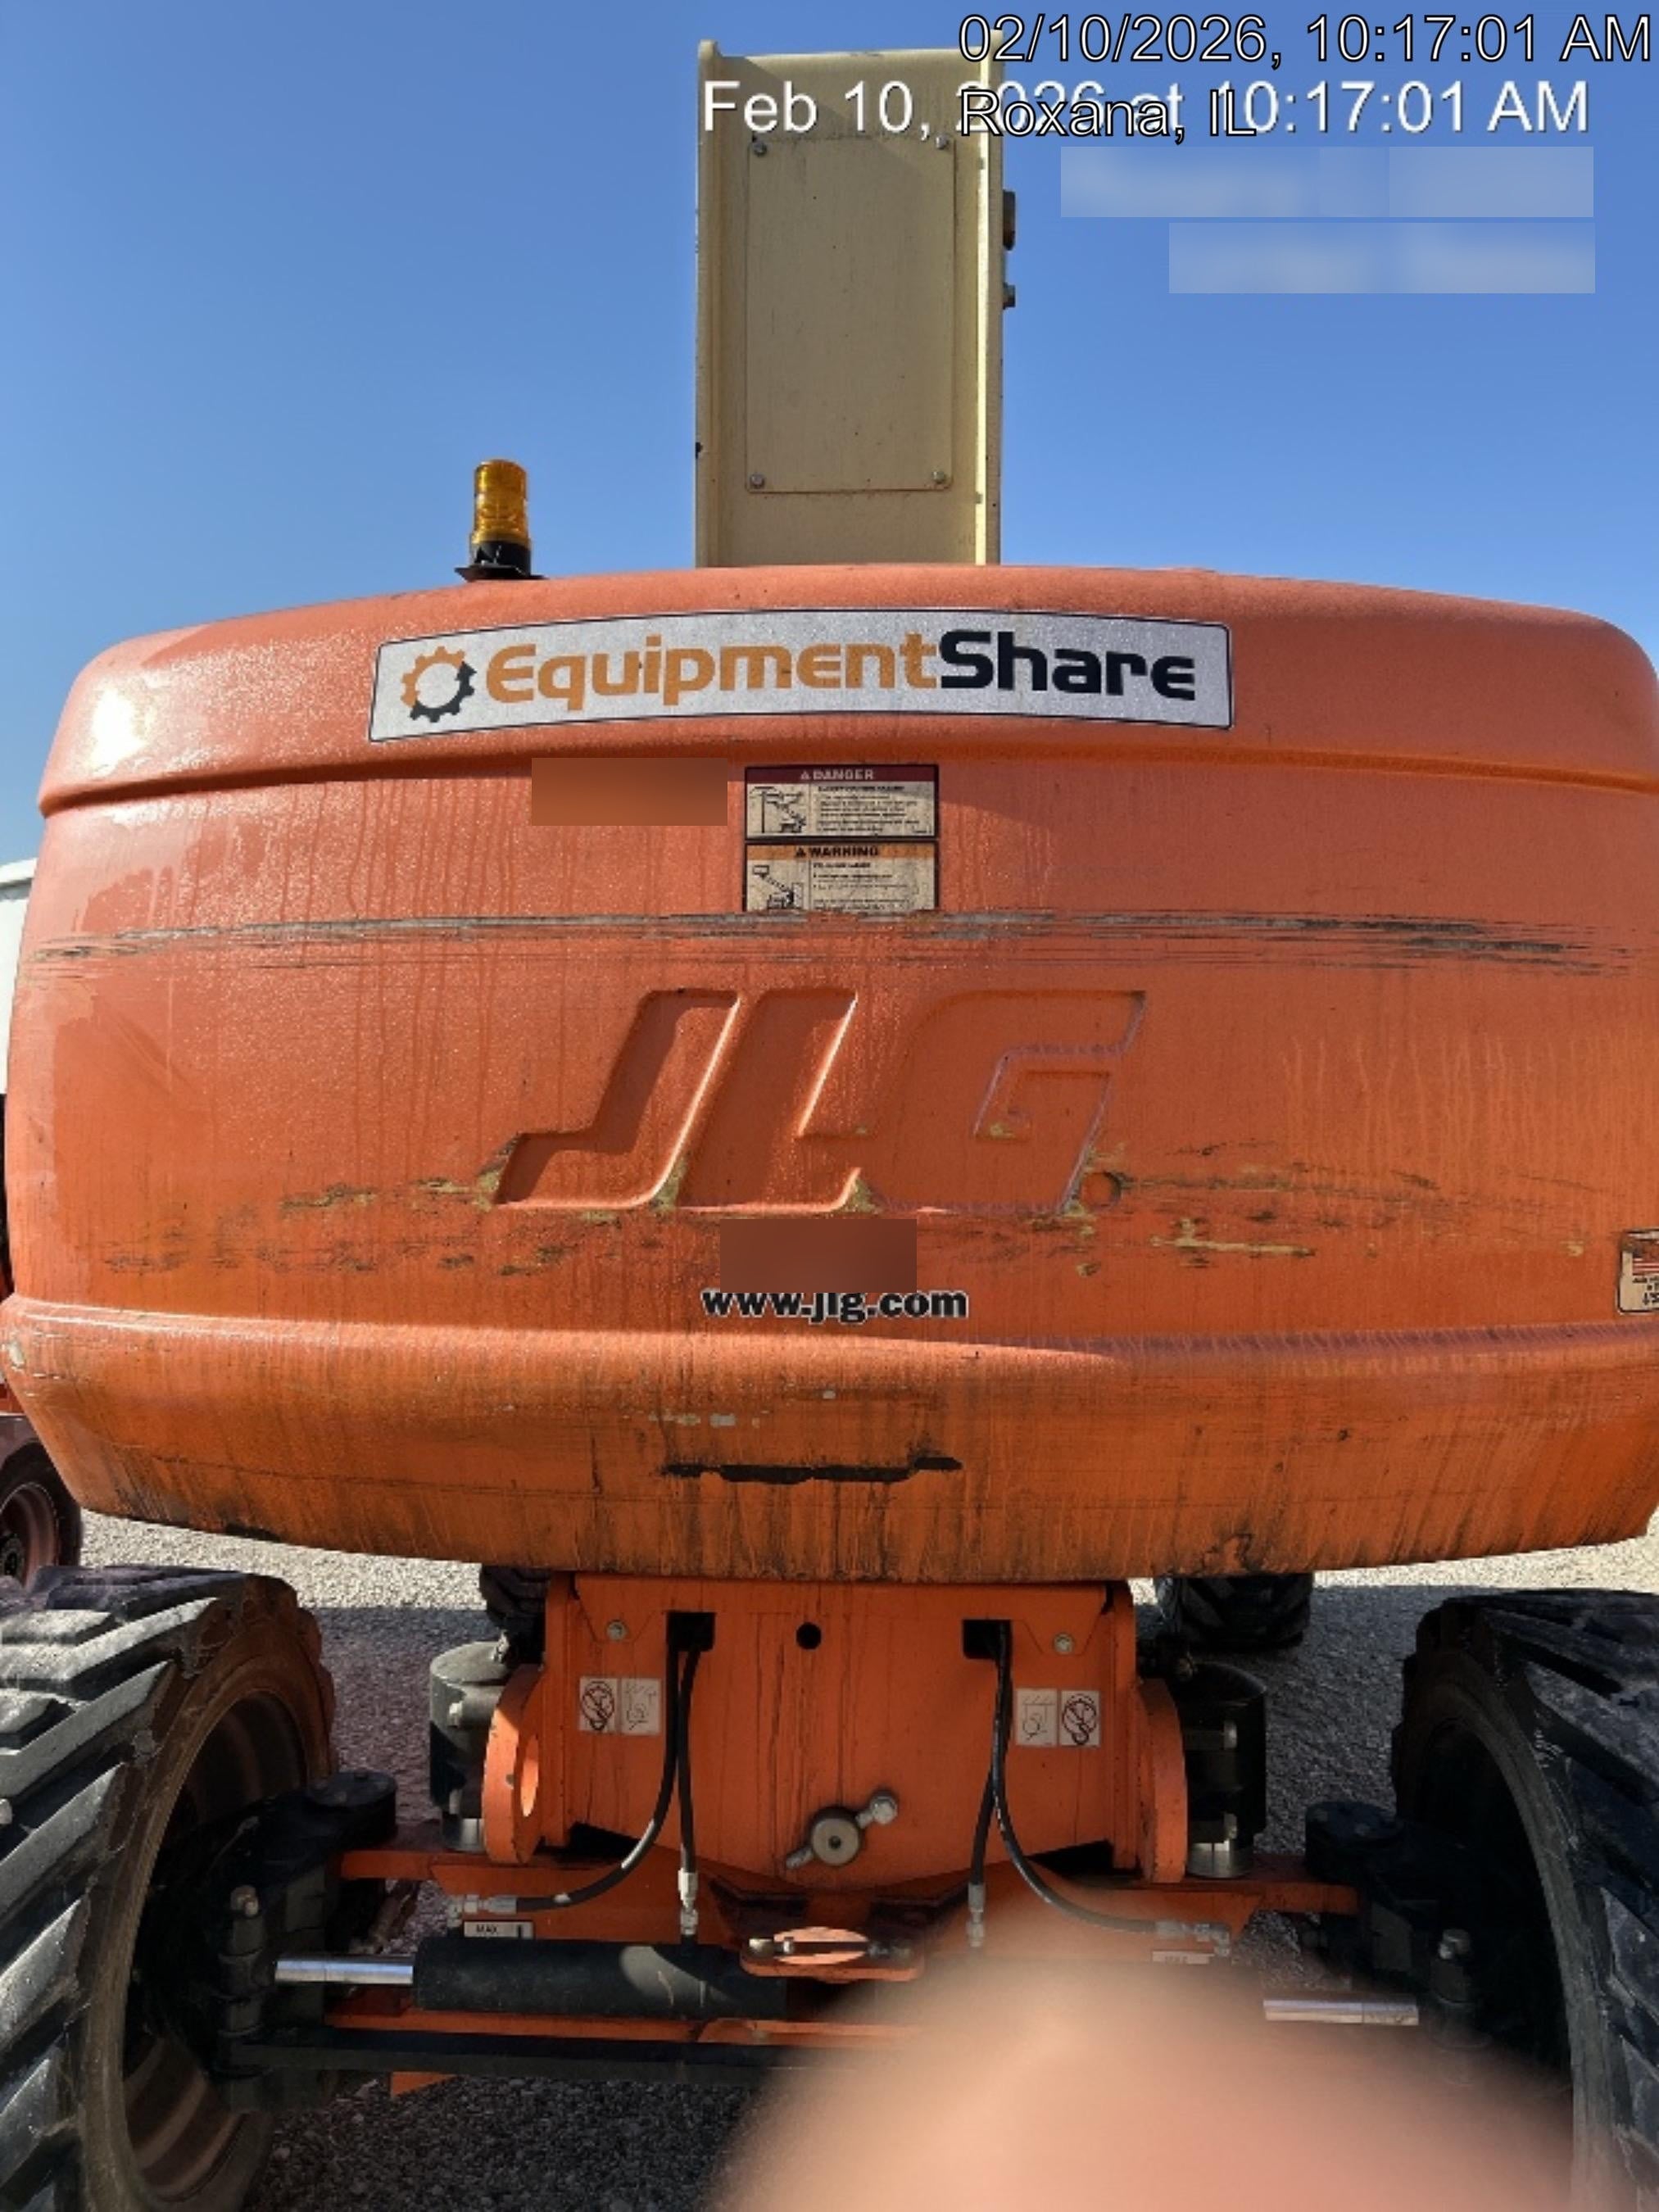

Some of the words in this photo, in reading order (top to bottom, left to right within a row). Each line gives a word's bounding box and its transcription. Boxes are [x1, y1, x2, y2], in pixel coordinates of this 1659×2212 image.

[486, 629, 1195, 711] EquipmentShare
[813, 769, 874, 781] DANGER
[810, 846, 878, 858] WARNING
[493, 990, 1145, 1211] JLG
[700, 1288, 968, 1325] www.jlg.com
